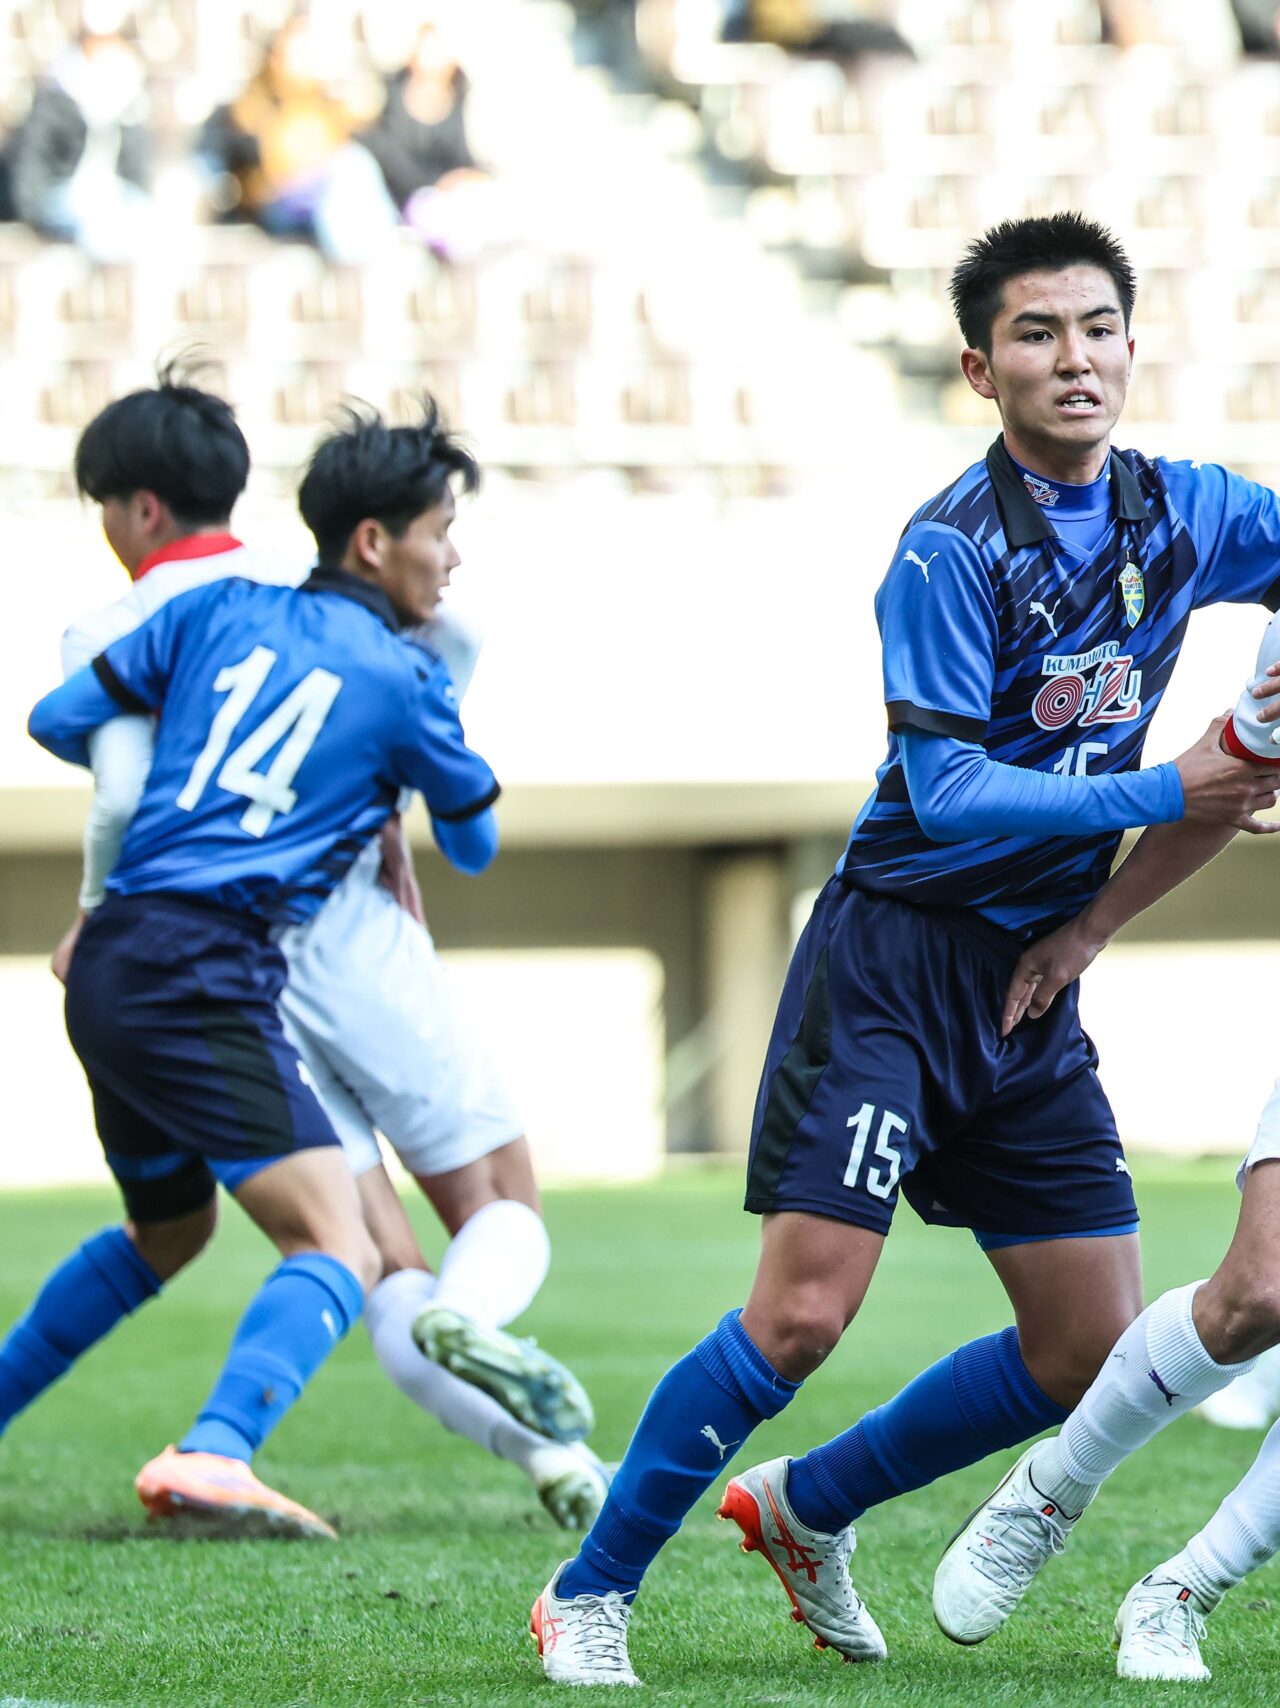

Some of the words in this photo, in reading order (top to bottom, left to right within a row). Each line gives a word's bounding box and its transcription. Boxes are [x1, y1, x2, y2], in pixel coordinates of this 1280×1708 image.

[1045, 643, 1119, 673] KUMAMOTO
[176, 645, 343, 838] 14
[842, 1102, 908, 1199] 15
